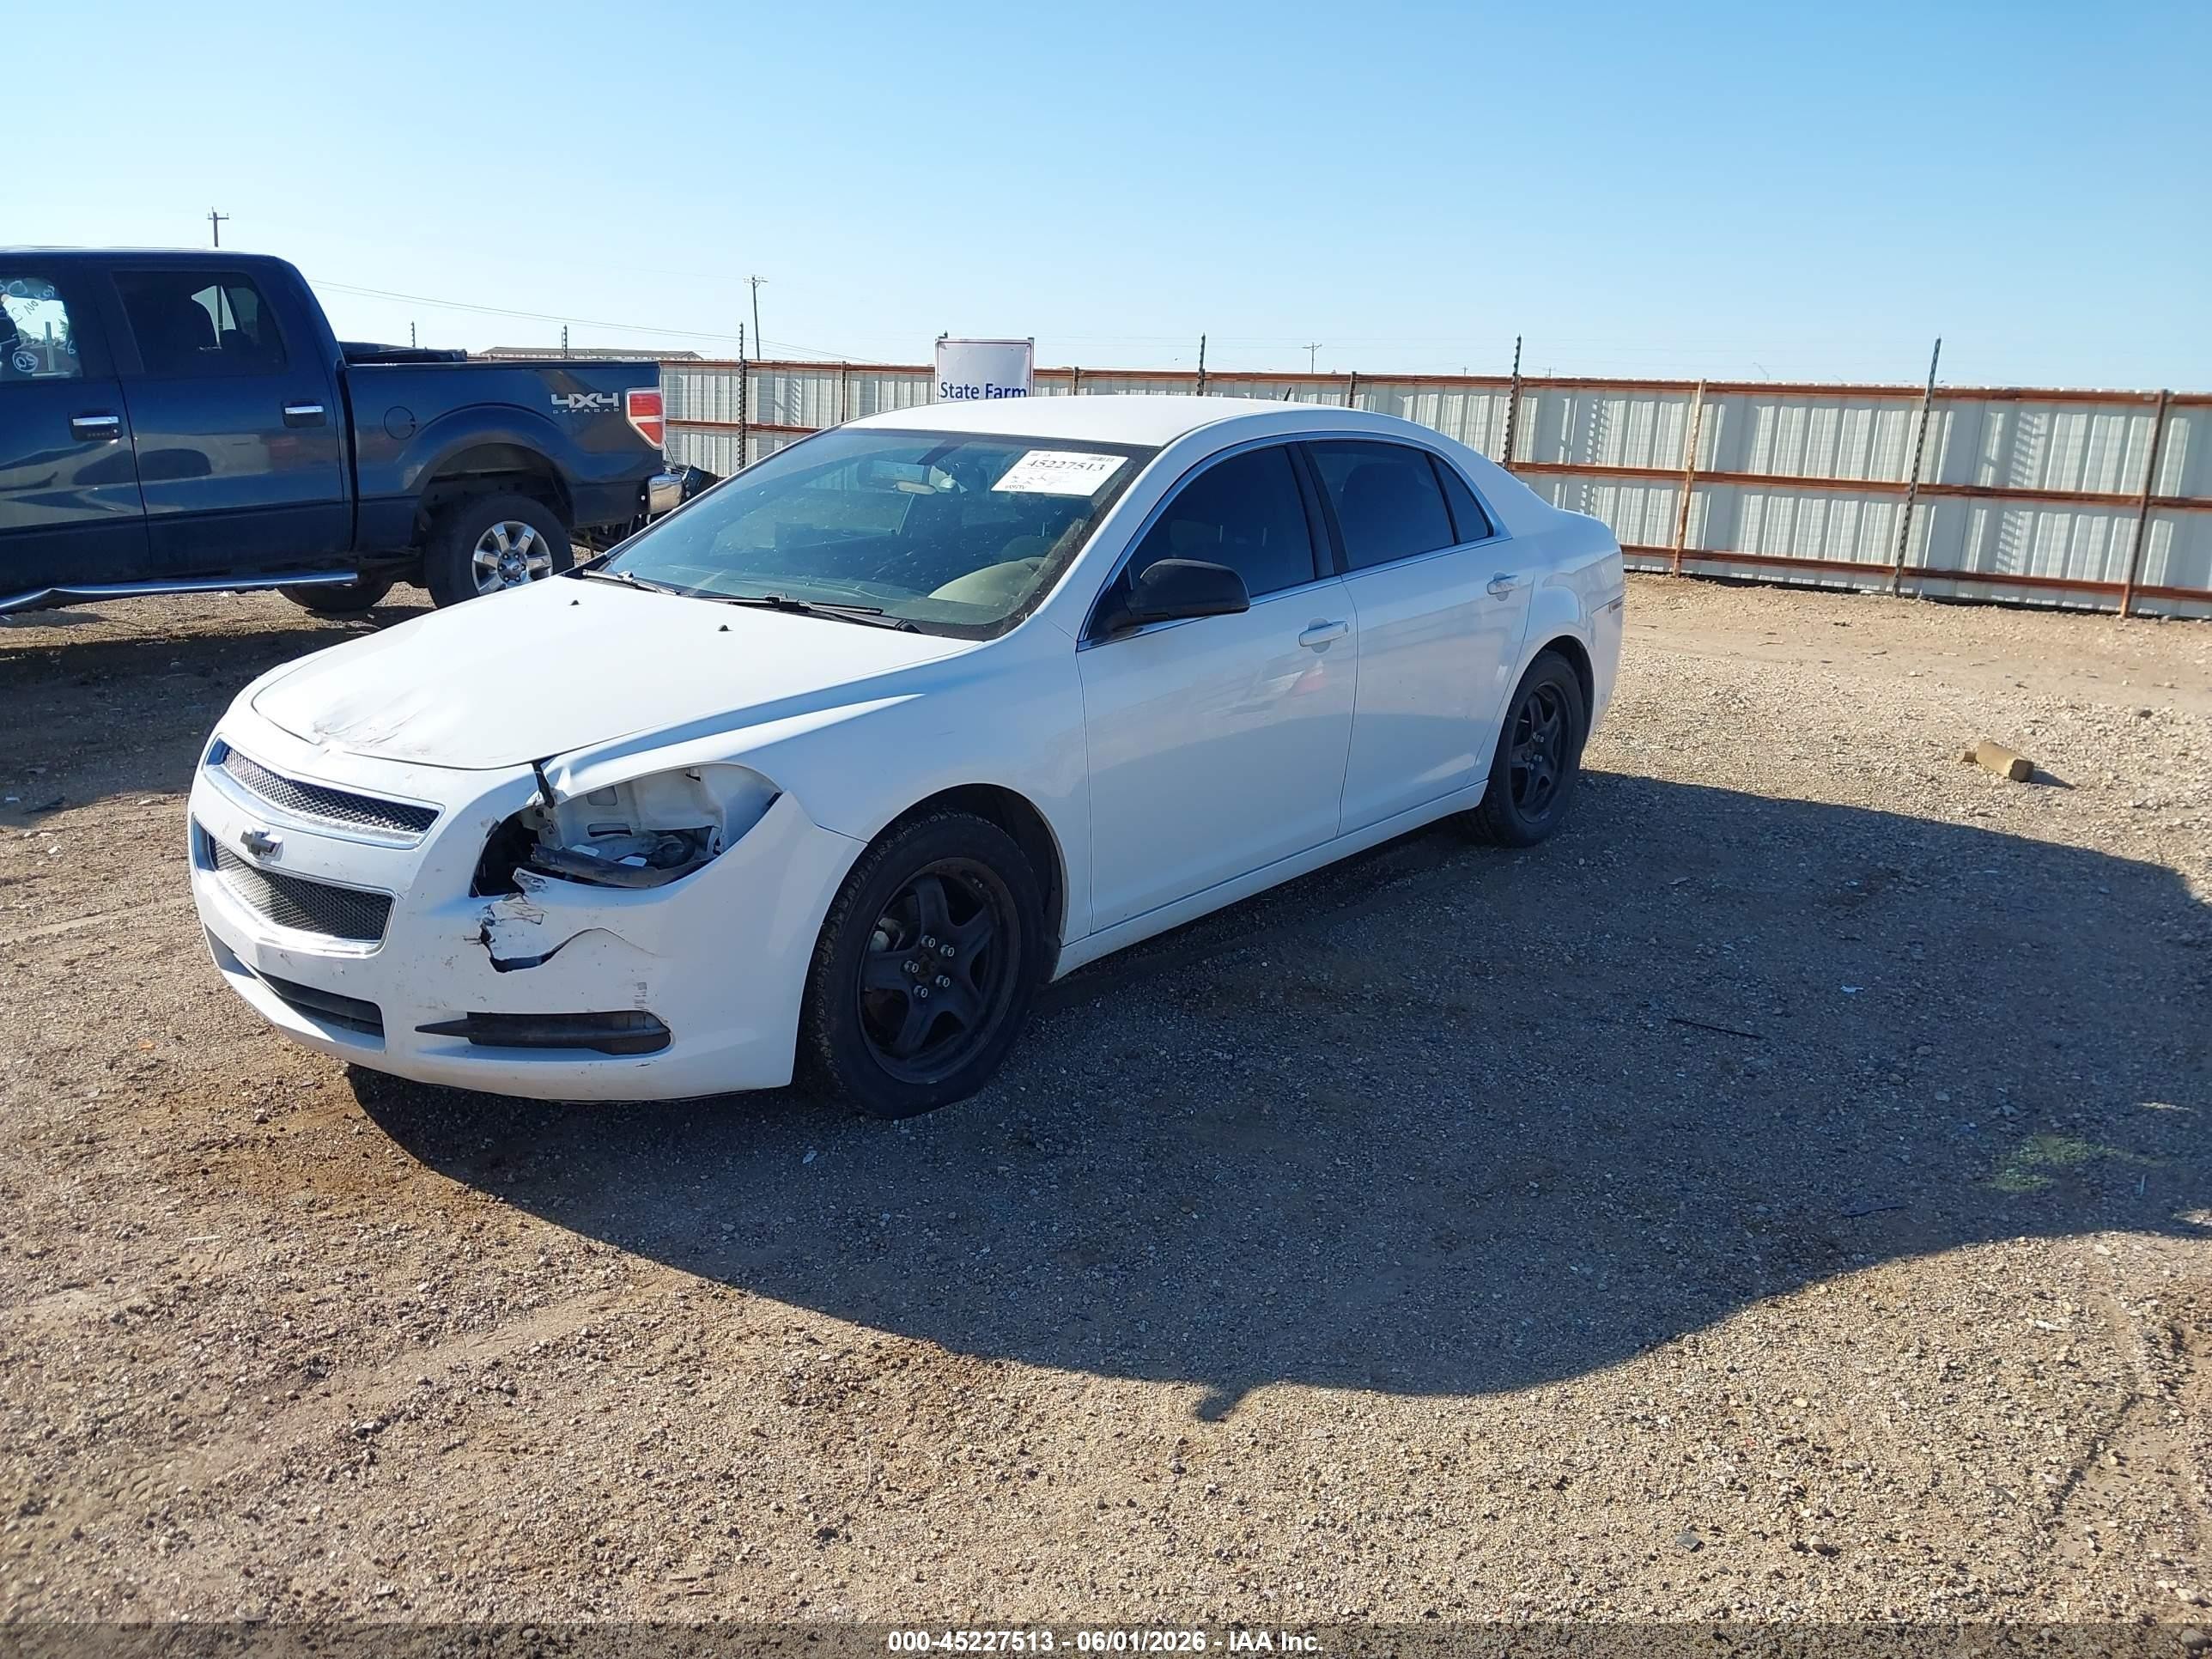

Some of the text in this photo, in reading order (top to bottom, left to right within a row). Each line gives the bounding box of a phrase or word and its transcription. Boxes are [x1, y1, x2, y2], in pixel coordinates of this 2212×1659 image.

[940, 382, 1027, 399] State Farm
[1026, 459, 1106, 471] 45227513
